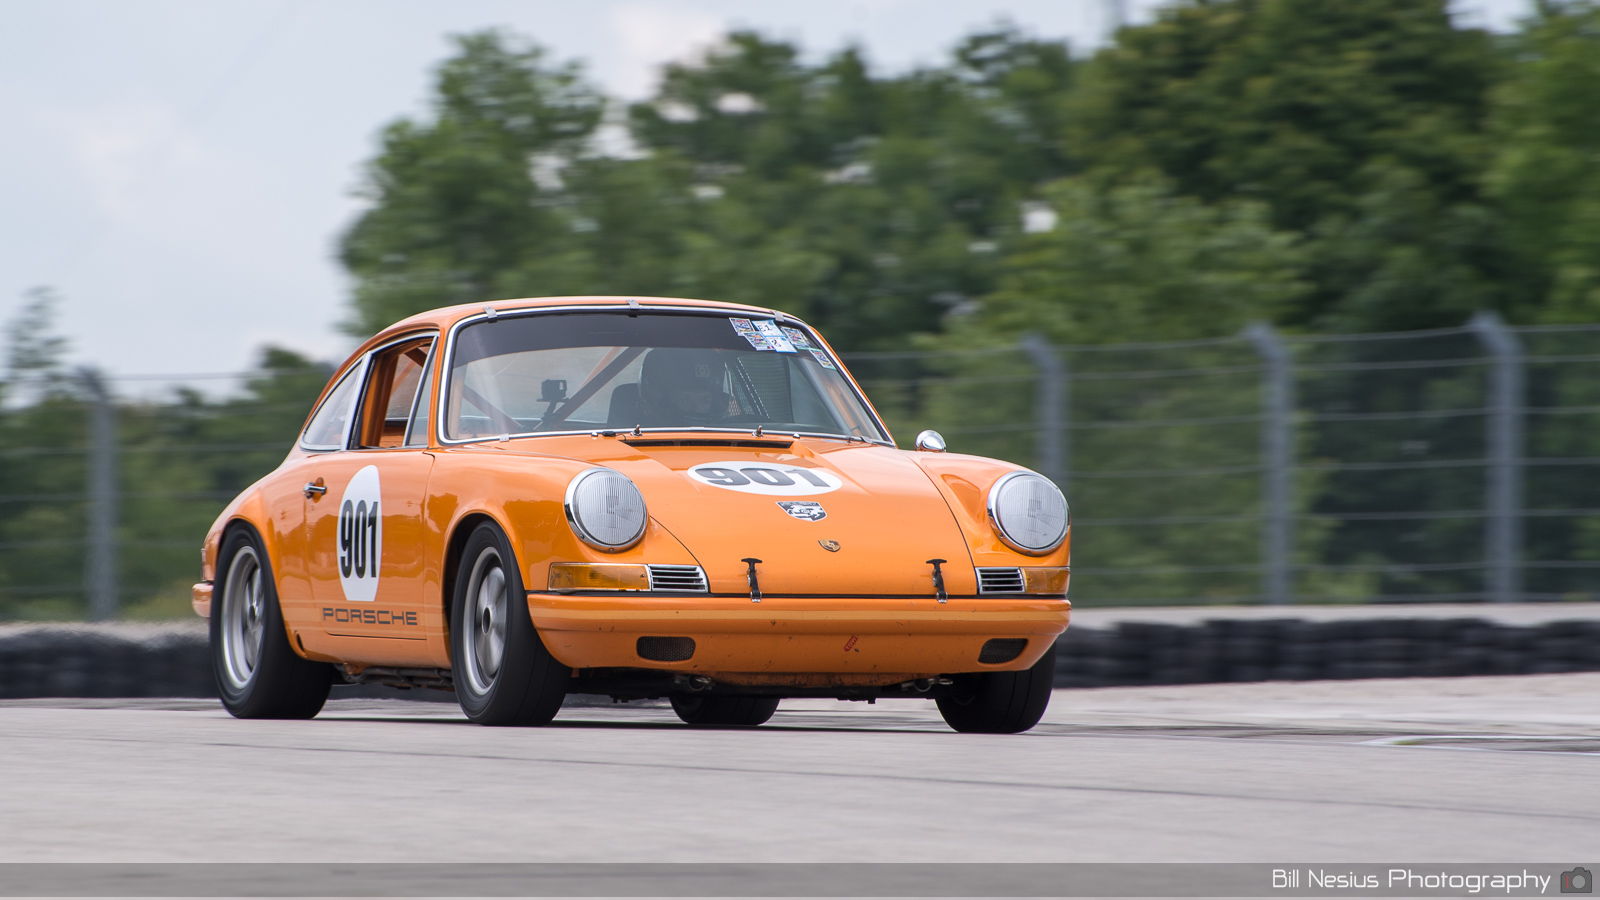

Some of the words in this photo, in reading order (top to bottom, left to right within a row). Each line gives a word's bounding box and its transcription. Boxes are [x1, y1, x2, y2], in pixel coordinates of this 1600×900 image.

[694, 467, 831, 488] 901
[340, 499, 378, 579] 901
[322, 607, 418, 626] PORSCHE
